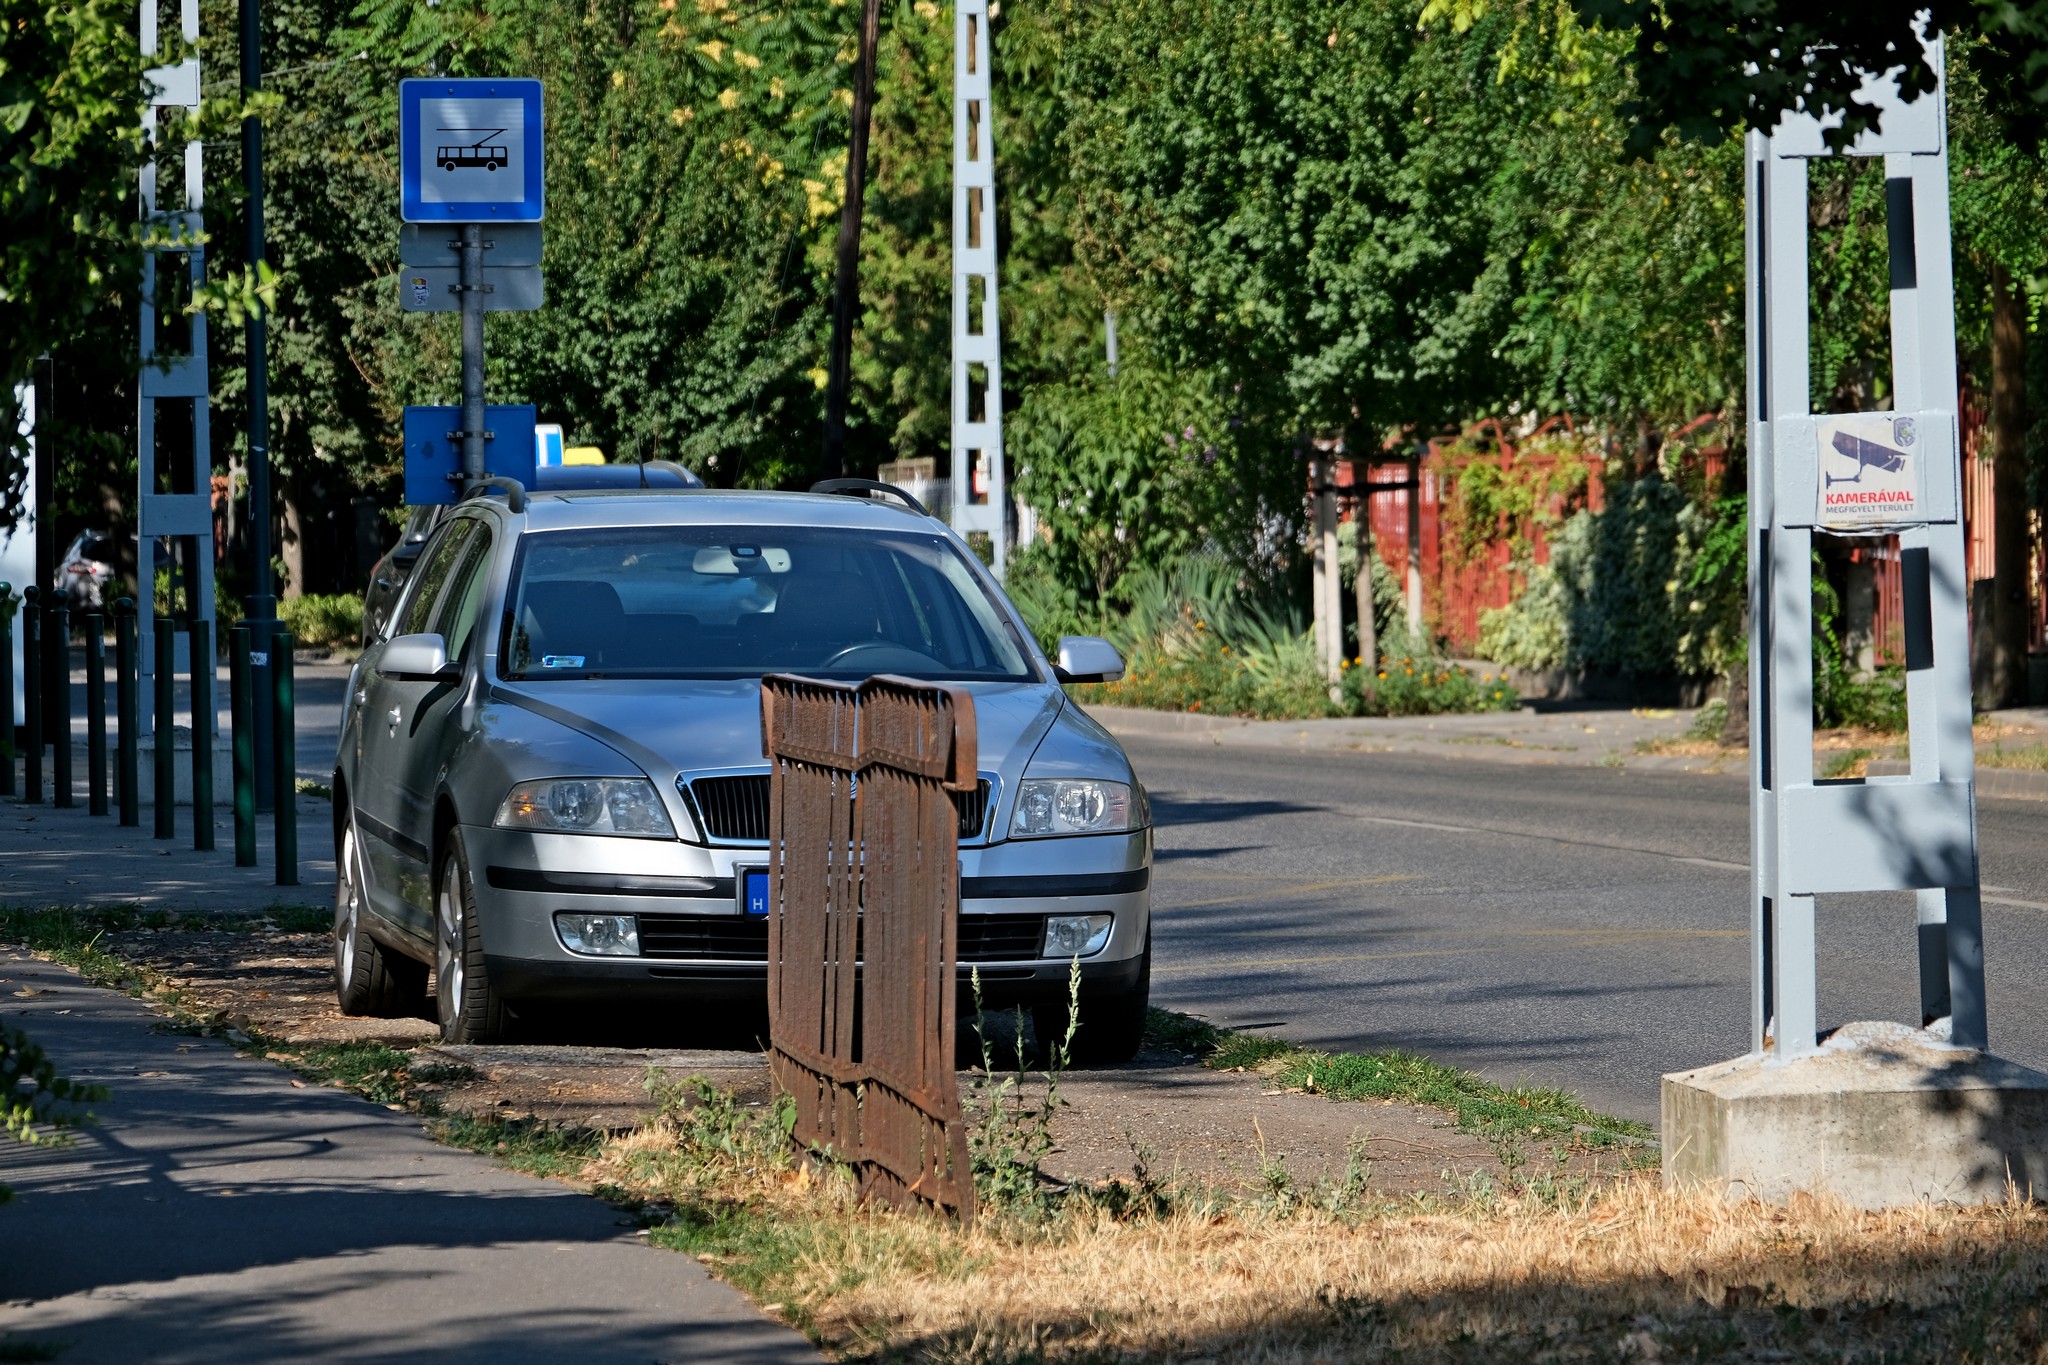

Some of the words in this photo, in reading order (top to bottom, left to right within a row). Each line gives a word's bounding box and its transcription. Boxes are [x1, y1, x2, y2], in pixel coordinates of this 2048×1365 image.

[1826, 489, 1914, 504] KAMERÁVAL
[1826, 504, 1878, 514] MEGFIGYELT
[1878, 503, 1914, 512] TERÜLET
[753, 898, 763, 910] H
